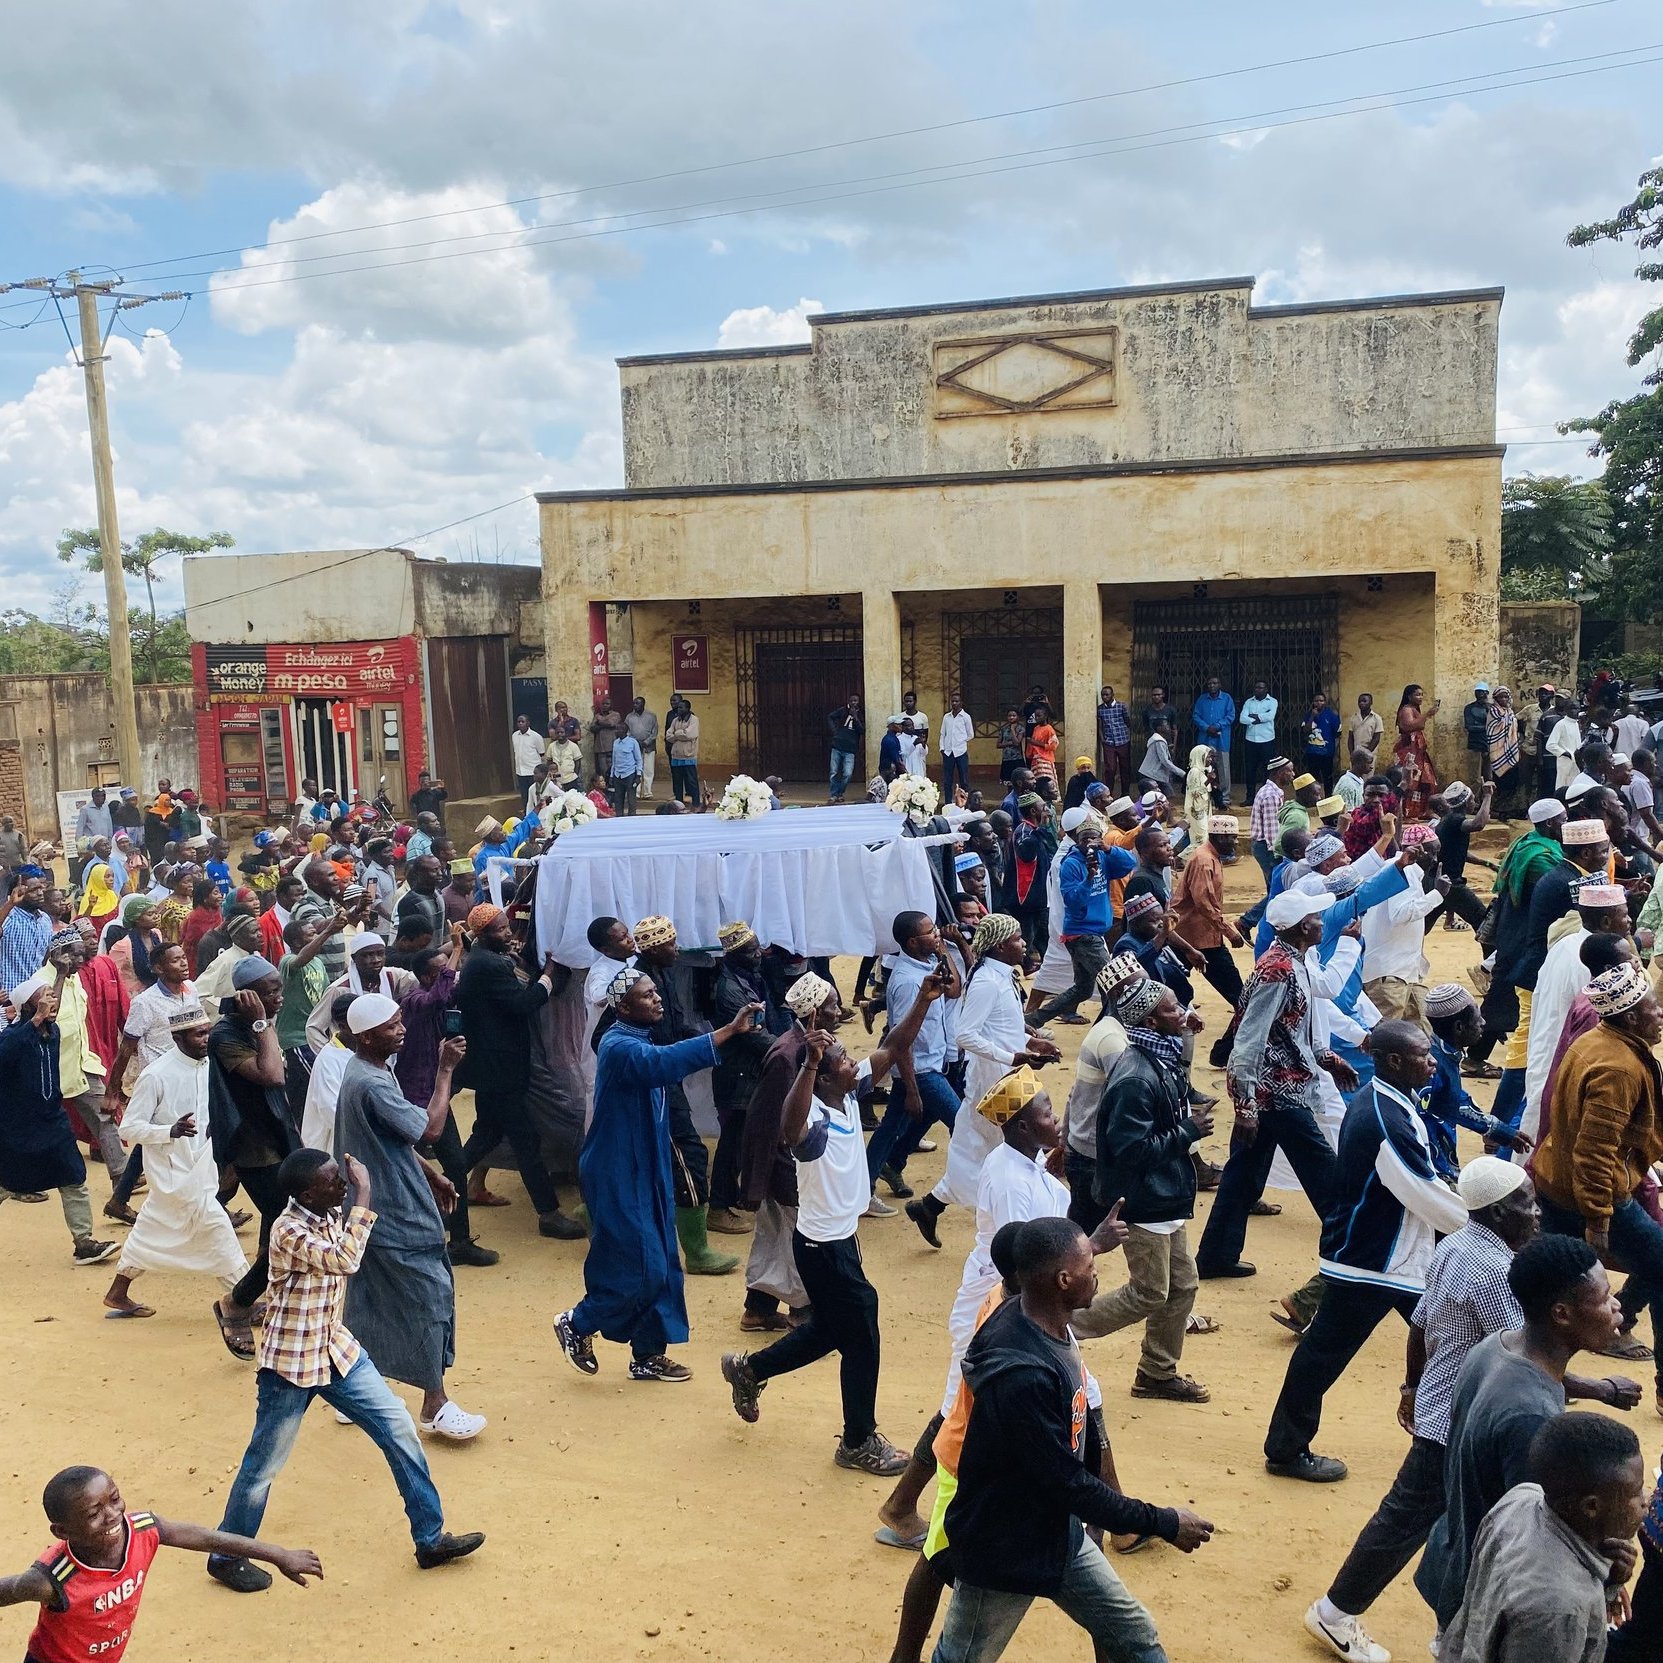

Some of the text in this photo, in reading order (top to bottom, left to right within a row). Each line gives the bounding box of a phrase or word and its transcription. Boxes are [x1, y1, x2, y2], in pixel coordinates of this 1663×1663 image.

[220, 662, 267, 677] orange
[680, 658, 700, 669] airtel
[359, 665, 396, 680] airtel
[220, 676, 265, 693] Money
